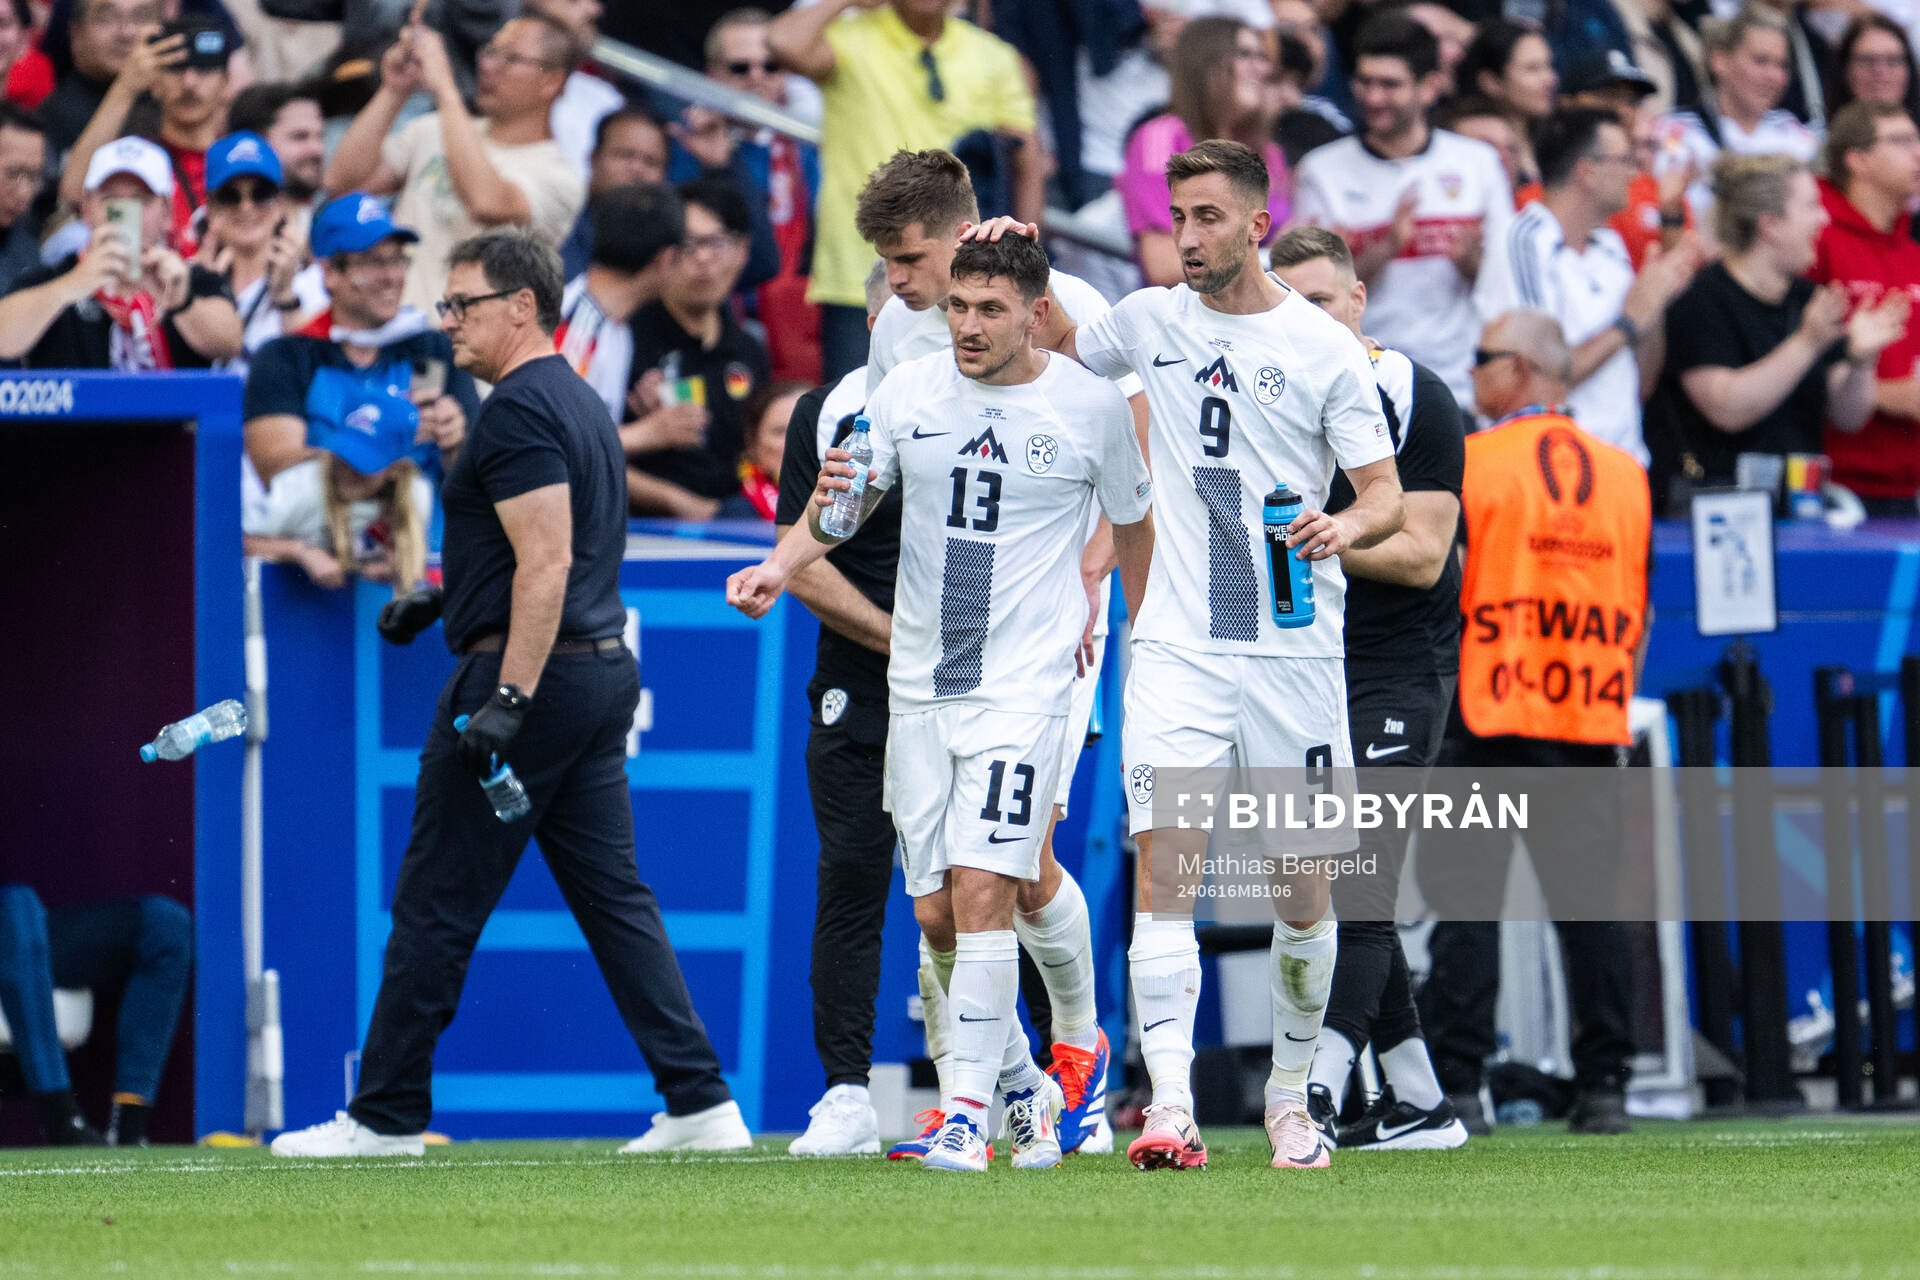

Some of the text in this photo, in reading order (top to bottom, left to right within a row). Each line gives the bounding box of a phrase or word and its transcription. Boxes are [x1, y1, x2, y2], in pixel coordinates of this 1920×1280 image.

[1199, 396, 1231, 458] 9
[946, 466, 1002, 532] 13
[1264, 525, 1289, 533] POWE
[980, 760, 1035, 826] 13
[1306, 744, 1333, 805] 9
